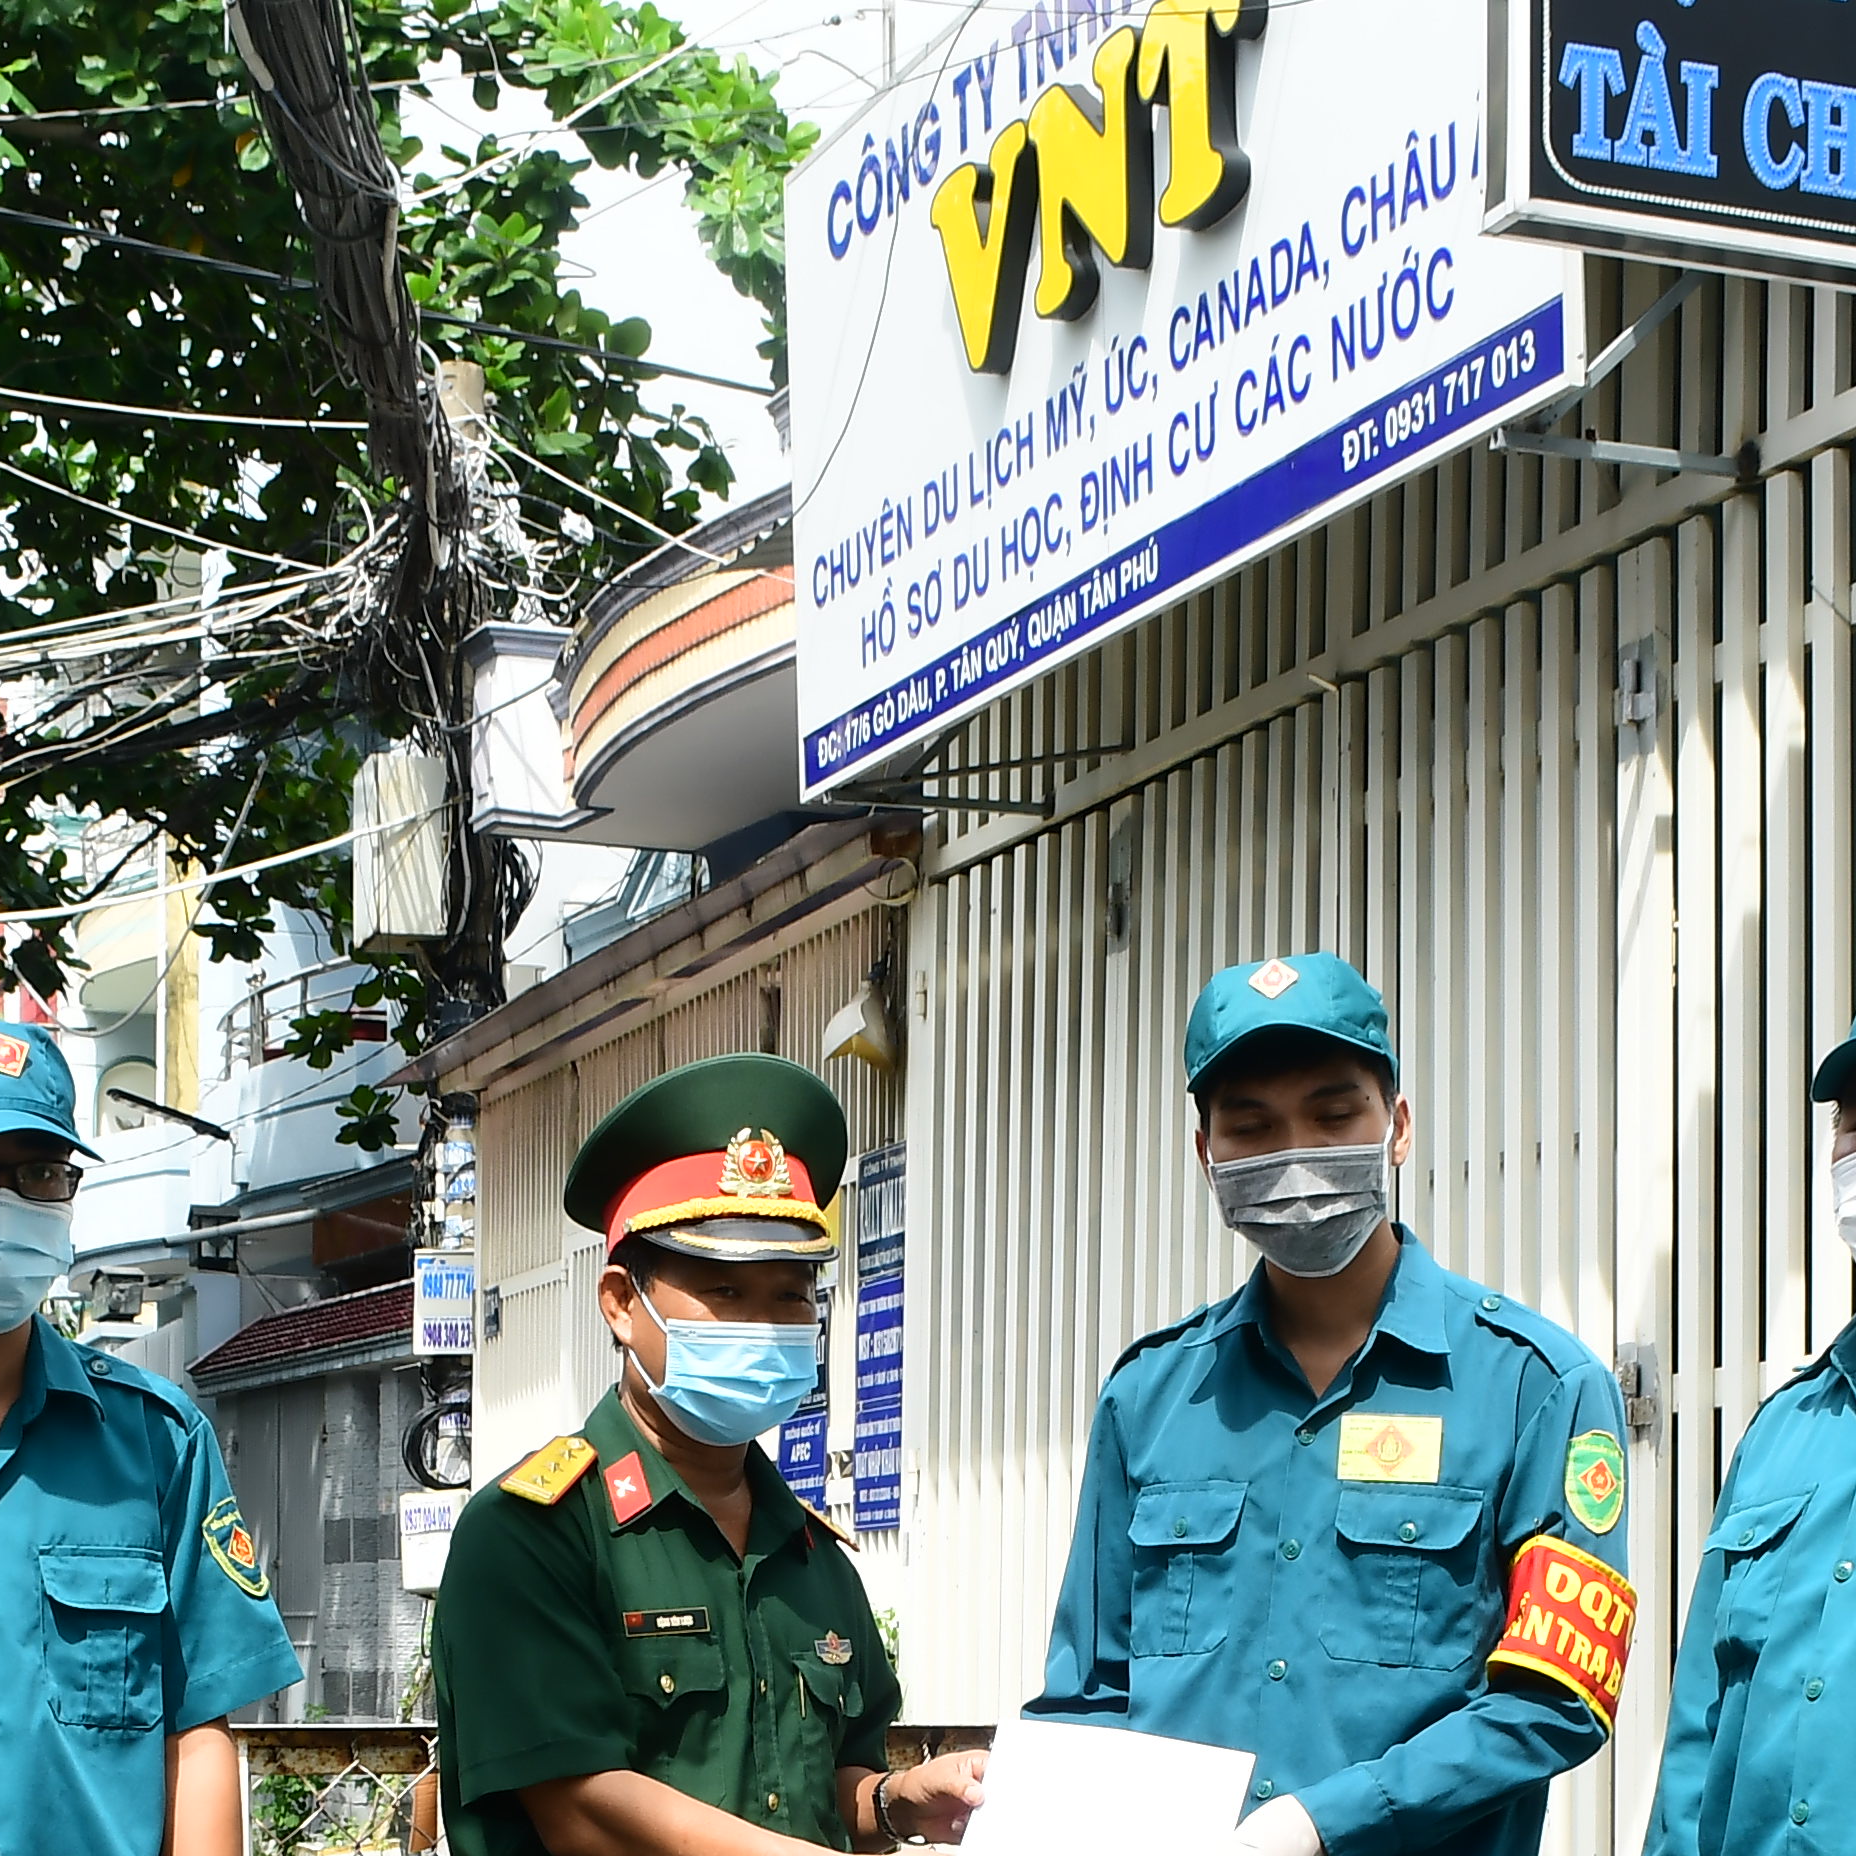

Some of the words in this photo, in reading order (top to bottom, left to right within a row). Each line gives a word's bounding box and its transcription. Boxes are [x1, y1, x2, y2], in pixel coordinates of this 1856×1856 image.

[828, 100, 941, 259] CÔNG
[953, 39, 1000, 154] TY
[930, 0, 1241, 371] VNT
[1558, 20, 1720, 179] TÀI
[813, 497, 913, 609] CHUYÊN
[924, 462, 959, 539] DU
[969, 411, 1034, 511] LỊCH
[1046, 361, 1095, 459] MỸ,
[1105, 335, 1158, 415] ÚC,
[1169, 221, 1330, 371] CANADA,
[1342, 129, 1456, 257] CHÂU
[861, 577, 896, 670] HỒ
[907, 559, 943, 639] SƠ
[954, 536, 991, 612] DU
[1001, 492, 1072, 583] HỌC,
[1080, 432, 1154, 536] ĐỊNH
[1168, 380, 1219, 476] CƯ
[1235, 334, 1312, 436] CÁC
[1331, 245, 1455, 383] NƯỚC
[1343, 426, 1379, 474] ĐT:
[1384, 388, 1436, 449] 0931
[1443, 355, 1485, 416] 717
[1491, 328, 1536, 389] 013
[844, 712, 871, 753] 17/6
[873, 691, 895, 736] GÒ
[935, 667, 948, 703] P.
[951, 648, 982, 692] TÂN
[985, 620, 1024, 672] QUÝ,
[1027, 590, 1077, 649] QUẬN
[1079, 568, 1116, 619] TÂN
[1120, 537, 1159, 598] PHÚ
[790, 1441, 811, 1463] APEC
[1546, 1561, 1635, 1653] DQT
[1555, 1617, 1609, 1684] TRA
